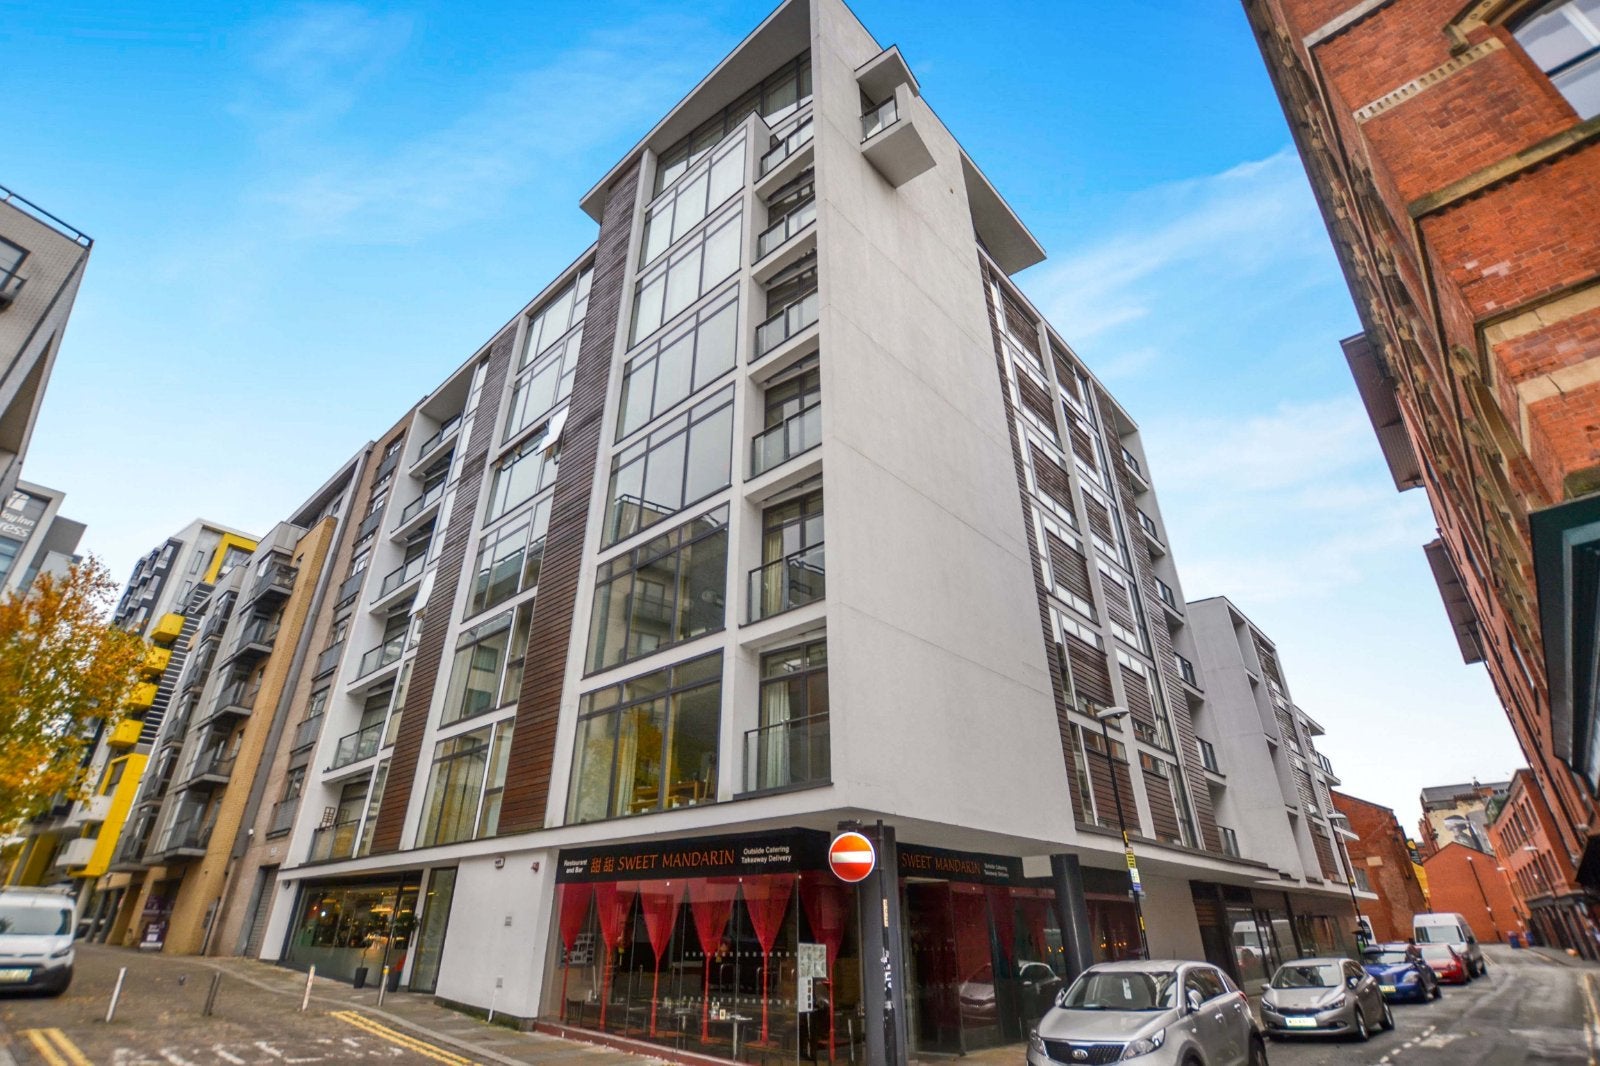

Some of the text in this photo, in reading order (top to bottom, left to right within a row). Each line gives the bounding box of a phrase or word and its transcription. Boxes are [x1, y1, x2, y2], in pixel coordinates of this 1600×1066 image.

[743, 845, 790, 855] Outside Catering
[563, 859, 588, 867] Restaurant
[617, 848, 735, 871] SWEET MANDARIN
[741, 855, 792, 864] Takeaway Delivery
[902, 853, 932, 869] SWEET
[935, 858, 981, 874] MANDARIN
